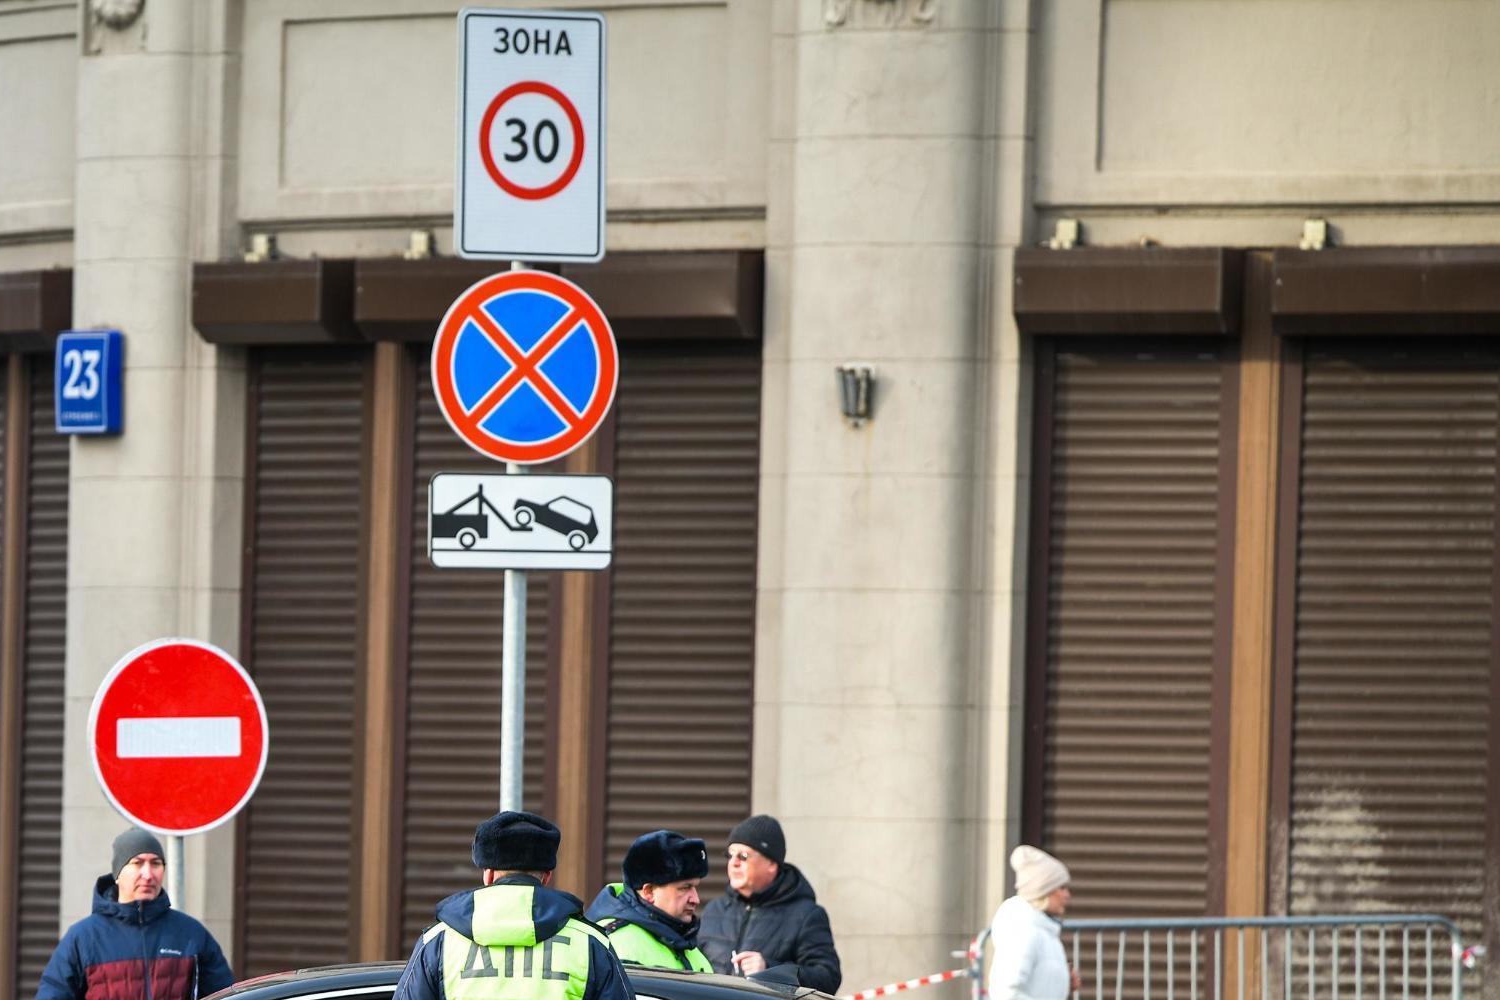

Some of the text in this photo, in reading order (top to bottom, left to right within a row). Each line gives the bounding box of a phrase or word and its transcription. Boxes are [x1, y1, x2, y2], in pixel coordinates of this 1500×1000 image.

[493, 27, 572, 56] ЗОНА
[504, 117, 560, 164] 30
[62, 349, 101, 400] 23
